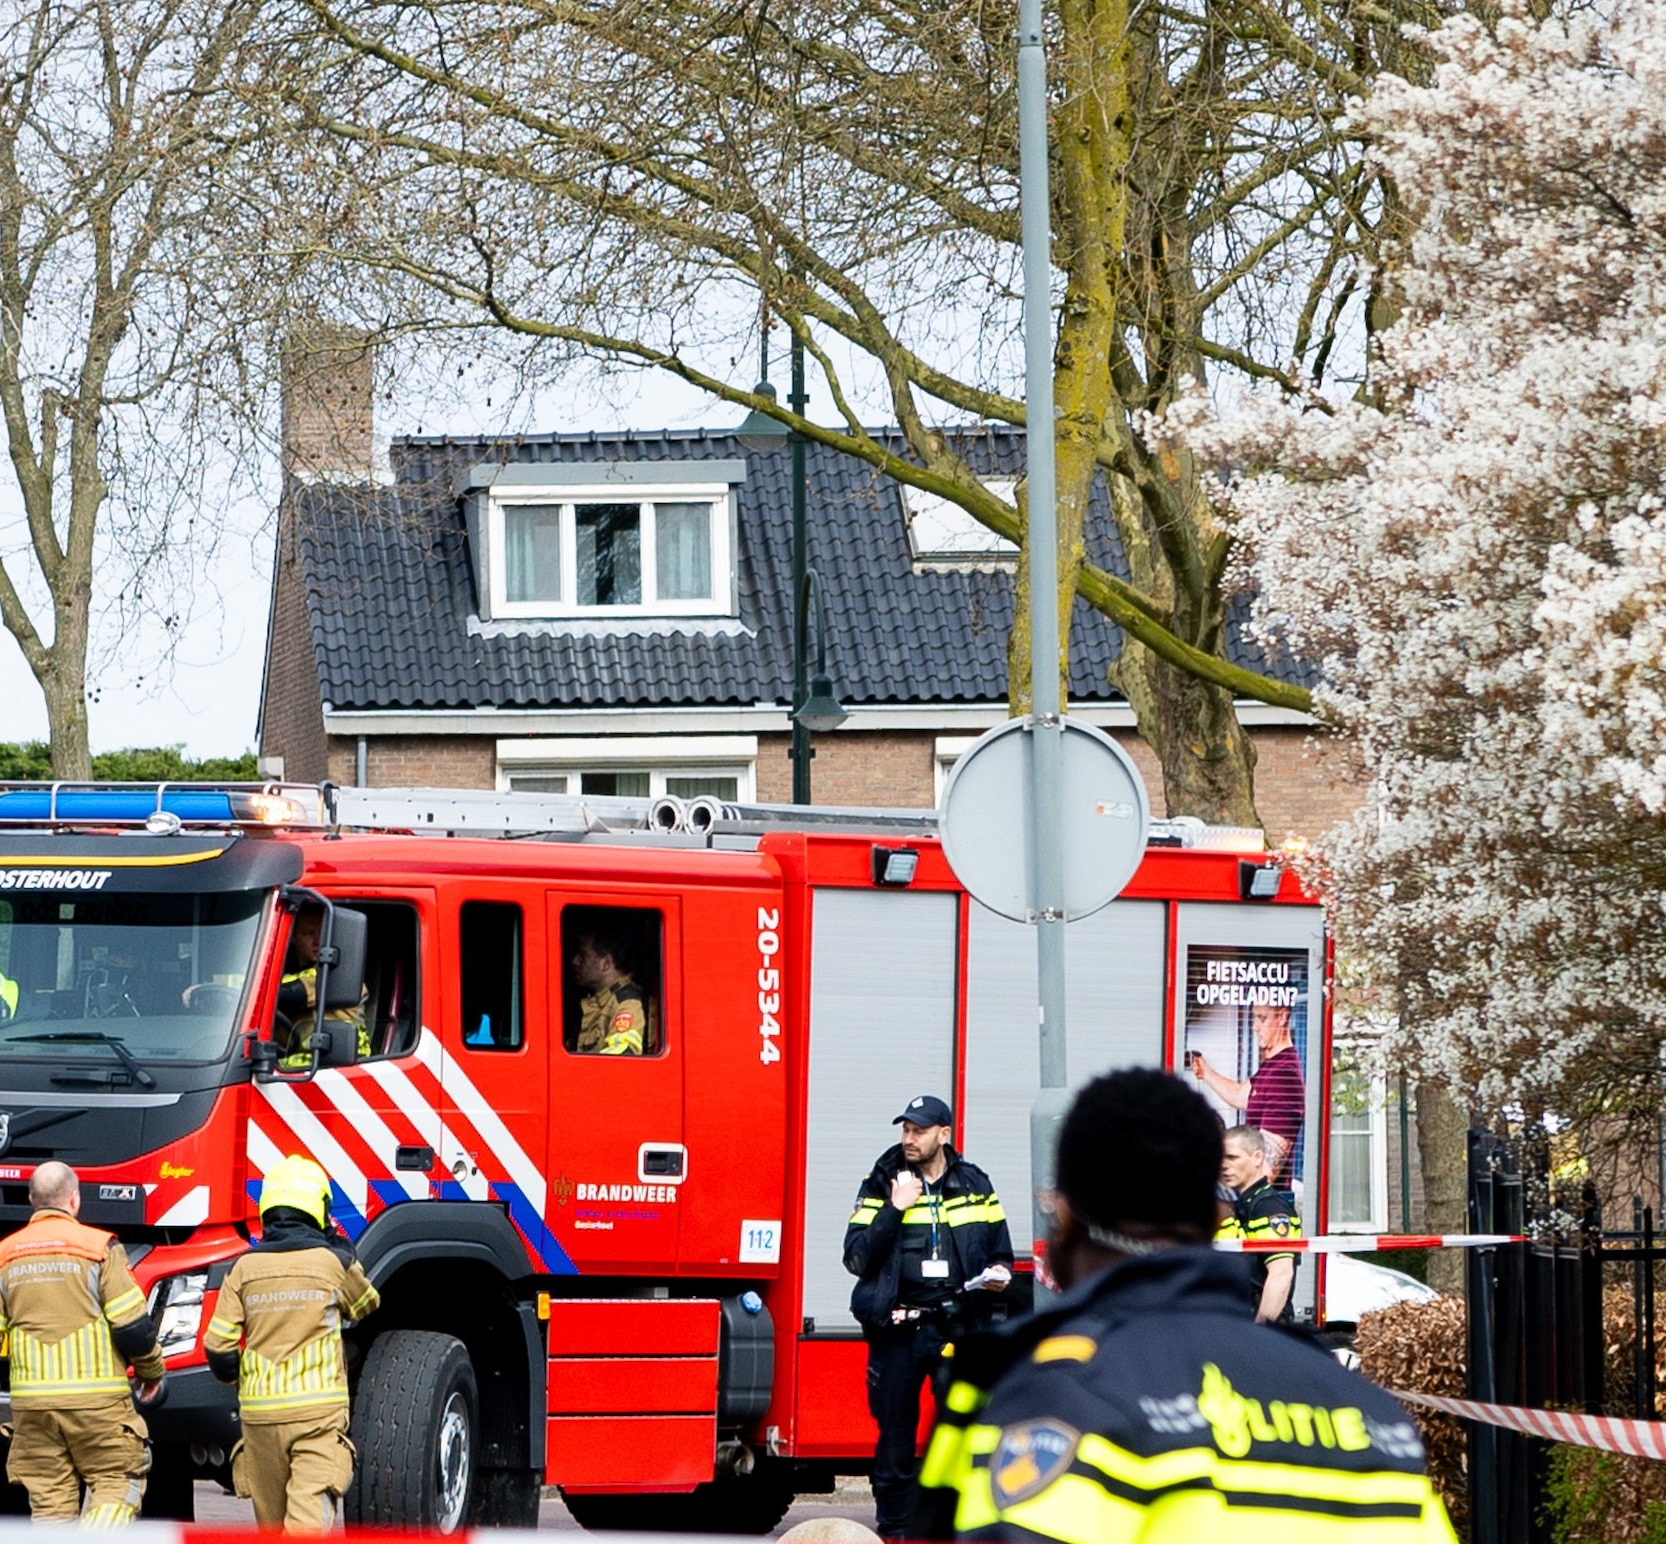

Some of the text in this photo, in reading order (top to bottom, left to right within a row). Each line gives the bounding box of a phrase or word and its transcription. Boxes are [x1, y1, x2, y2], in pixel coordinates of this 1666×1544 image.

[1206, 961, 1288, 983] FIETSACCU
[757, 907, 780, 1065] 20-5344
[1197, 984, 1298, 1007] OPGELADEN?
[576, 1183, 677, 1204] BRANDWEER
[7, 1261, 82, 1280] BRANDWEER
[245, 1289, 324, 1306] BRANDWEER
